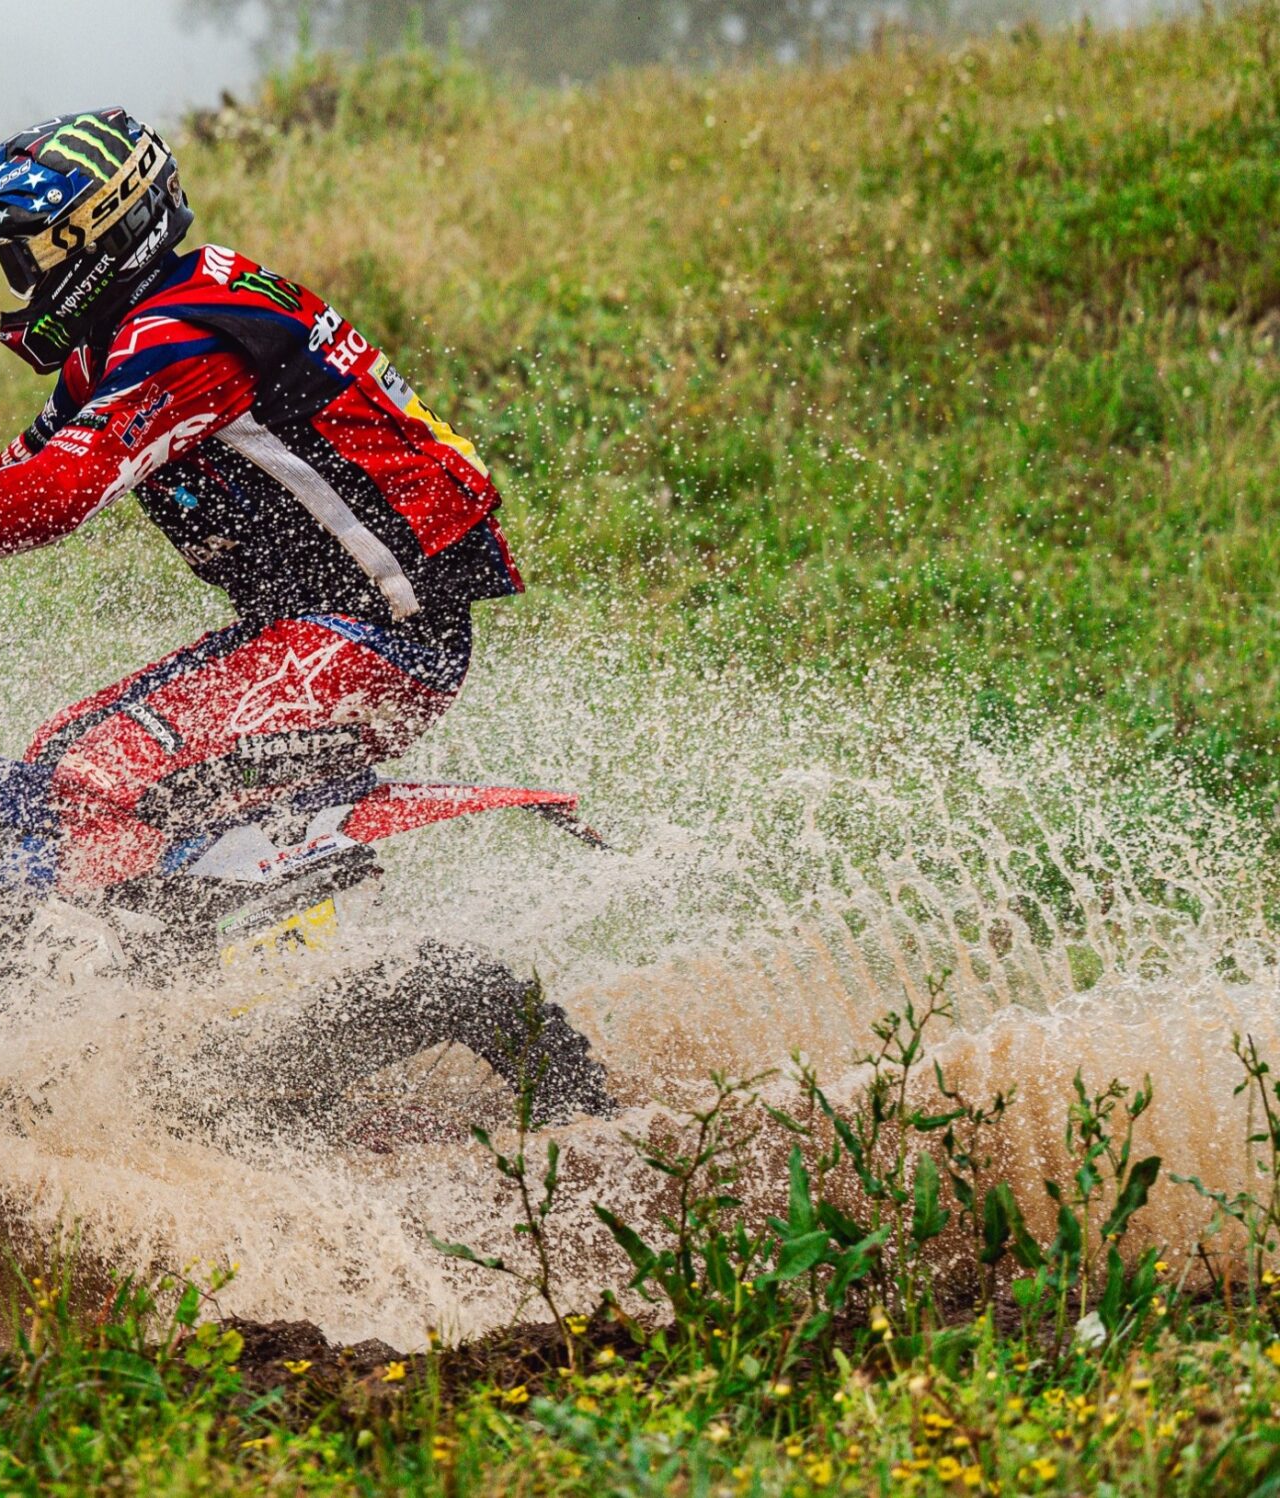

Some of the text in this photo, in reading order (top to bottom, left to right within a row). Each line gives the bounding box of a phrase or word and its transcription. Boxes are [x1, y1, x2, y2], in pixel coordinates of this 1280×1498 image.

[55, 253, 116, 318] MONSTER
[74, 270, 115, 318] ENERGY
[129, 268, 161, 306] HONDA
[55, 429, 94, 445] OTUL
